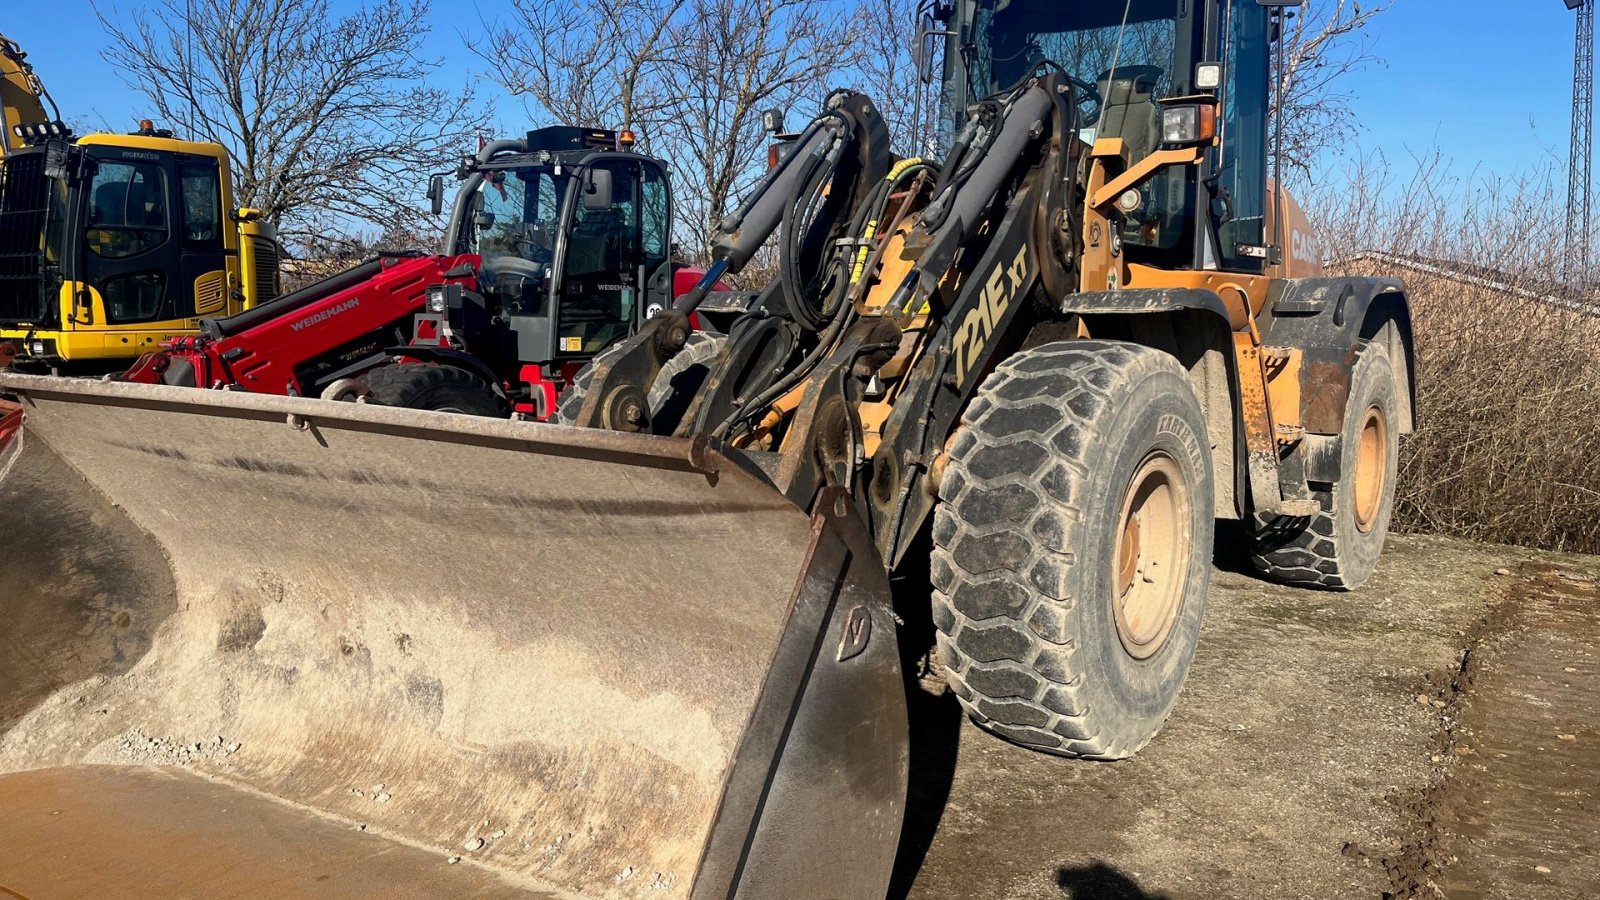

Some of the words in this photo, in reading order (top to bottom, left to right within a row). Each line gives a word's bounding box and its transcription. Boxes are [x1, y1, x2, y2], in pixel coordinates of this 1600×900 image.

[290, 297, 360, 332] WEIDEMANN
[952, 260, 1009, 389] 721E
[1006, 242, 1027, 300] XT
